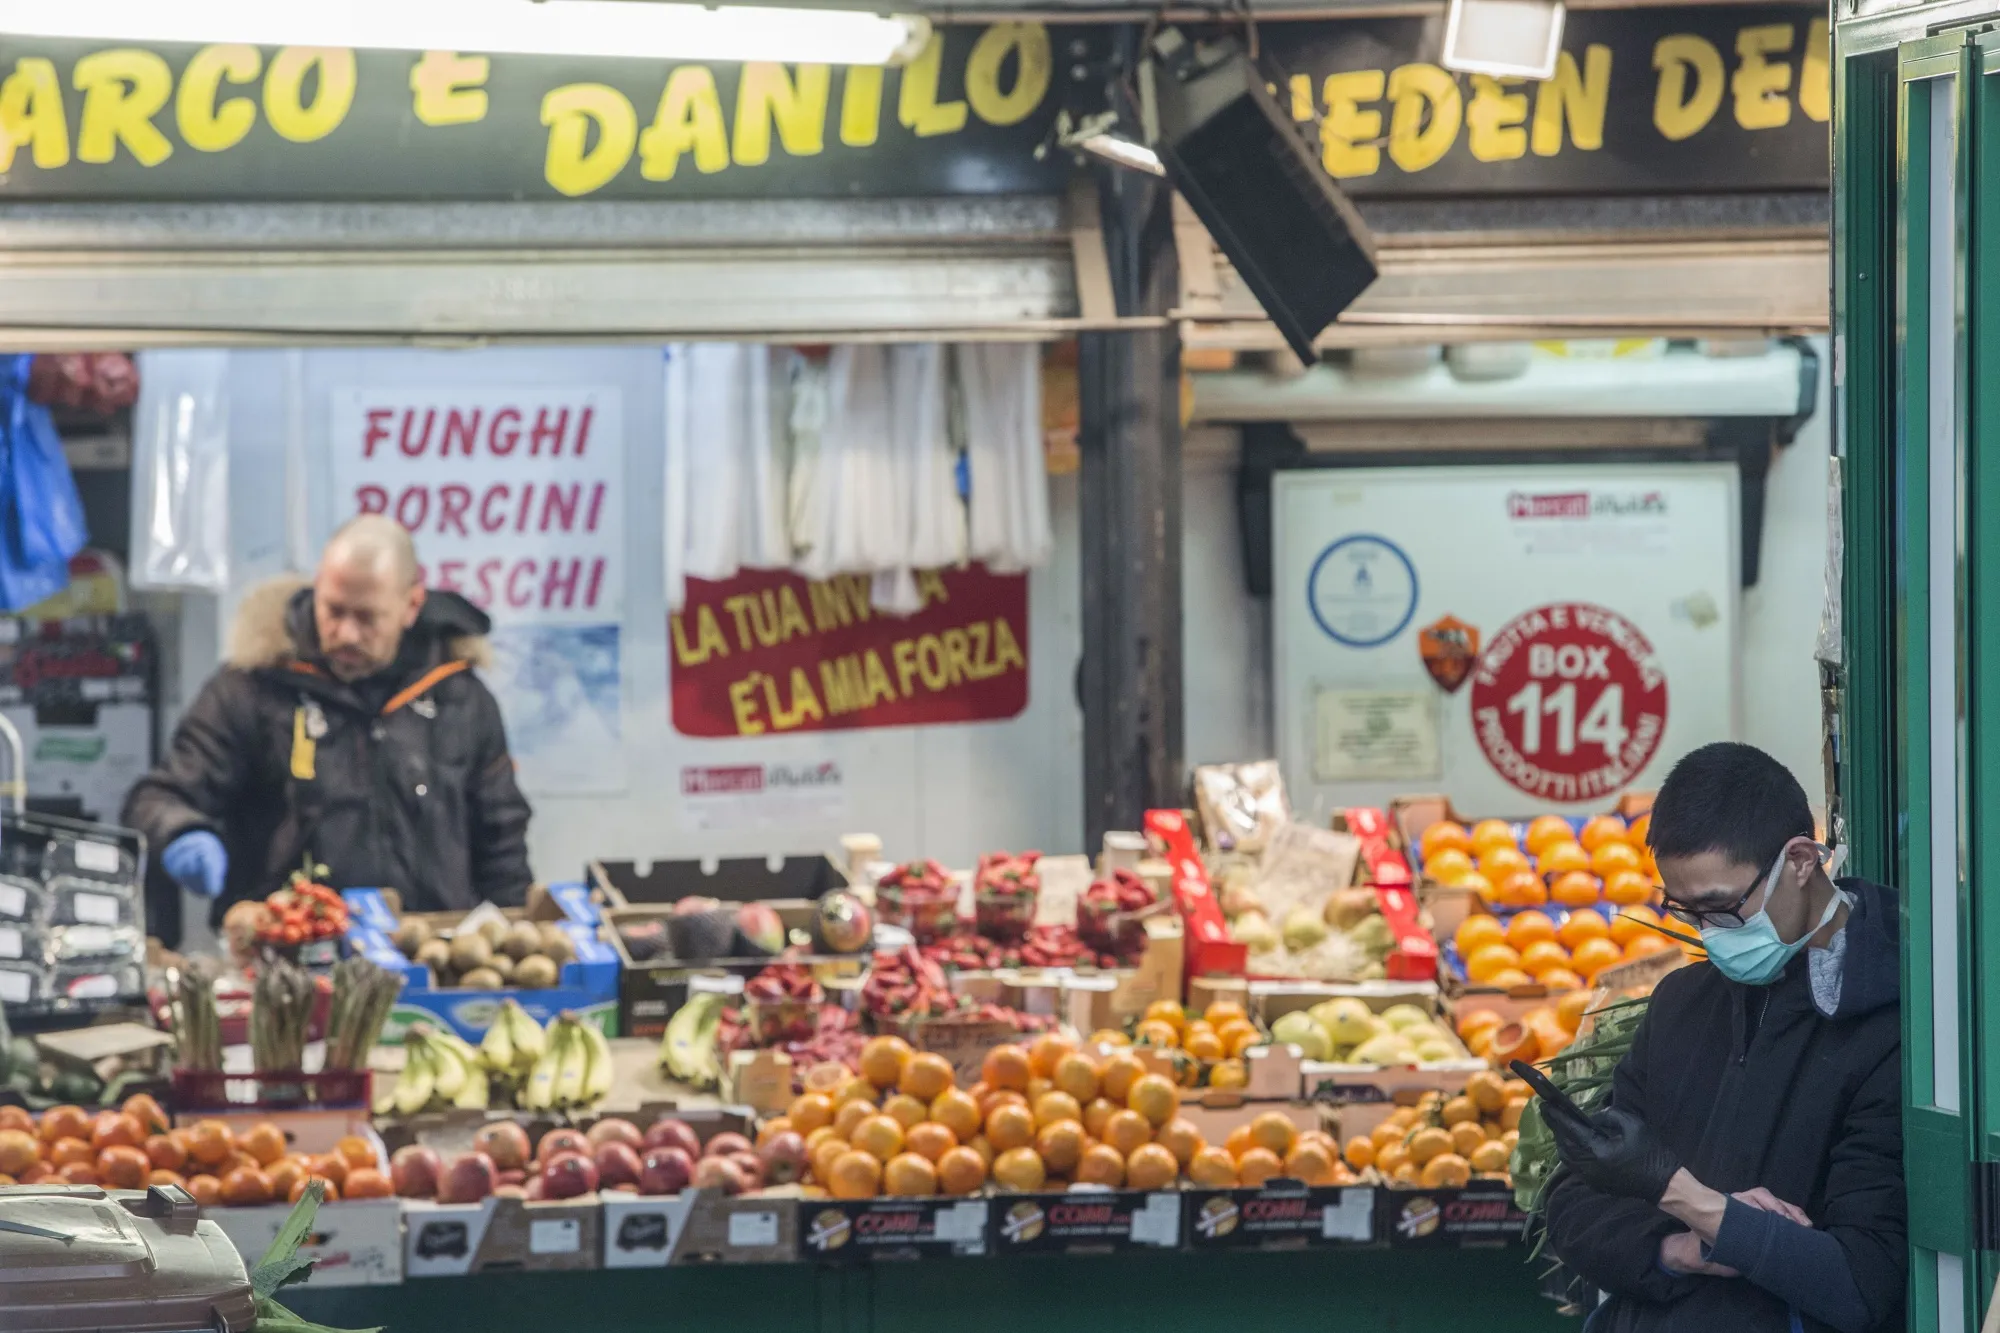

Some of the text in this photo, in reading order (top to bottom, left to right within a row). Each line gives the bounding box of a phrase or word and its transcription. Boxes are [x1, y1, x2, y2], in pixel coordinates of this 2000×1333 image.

[410, 50, 489, 126] E
[541, 21, 1051, 196] DANILO
[362, 406, 595, 458] FUNGHI
[671, 604, 730, 667] LA
[724, 583, 812, 651] TUA
[1549, 606, 1570, 630] E
[763, 666, 824, 730] LA
[819, 648, 898, 716] MIA
[892, 618, 1025, 697] FORZA
[1528, 643, 1610, 679] BOX
[1507, 680, 1630, 756] 114
